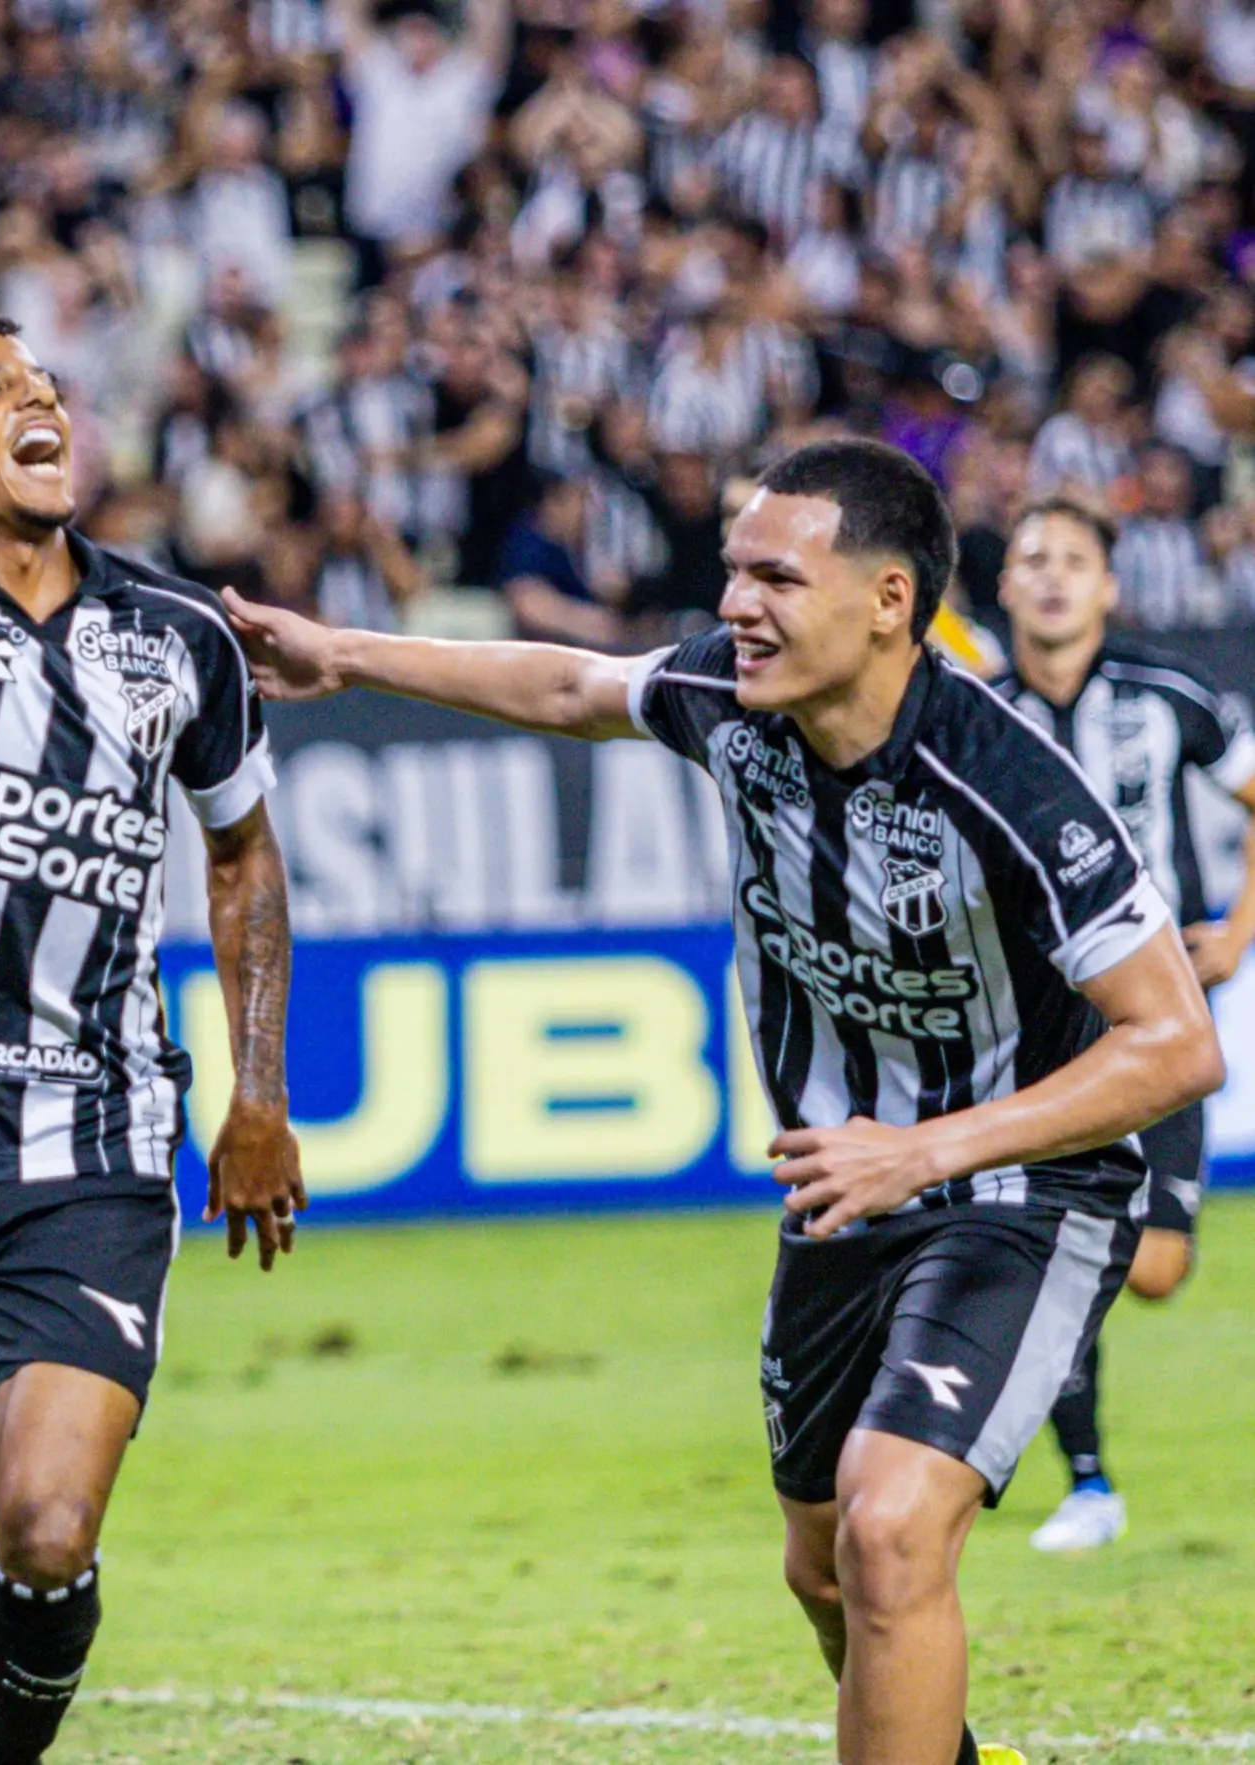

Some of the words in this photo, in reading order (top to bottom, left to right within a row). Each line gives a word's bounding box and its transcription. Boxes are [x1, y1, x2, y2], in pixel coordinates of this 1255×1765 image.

[78, 622, 173, 662] genial
[105, 653, 170, 678] BANCO
[744, 761, 809, 808] BANCO
[850, 788, 944, 837] genial
[873, 823, 944, 858] BANCO
[176, 952, 786, 1198] UB
